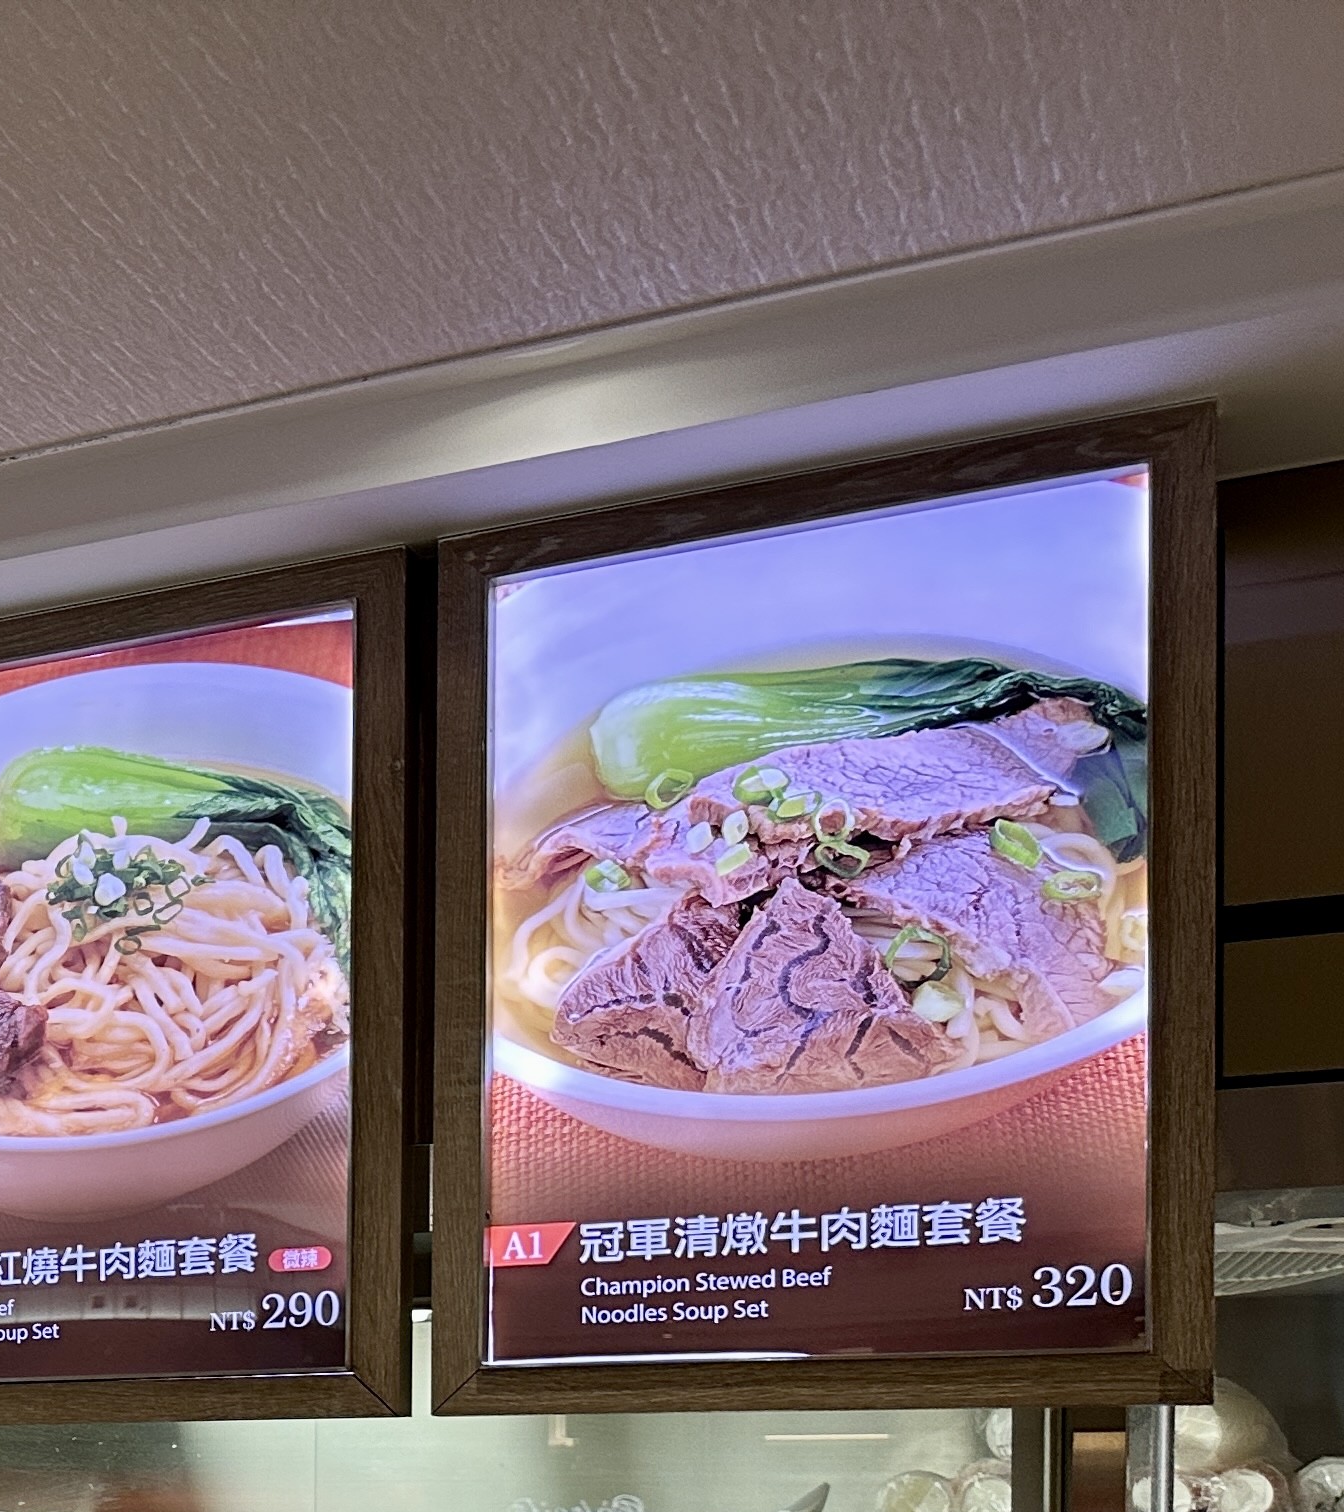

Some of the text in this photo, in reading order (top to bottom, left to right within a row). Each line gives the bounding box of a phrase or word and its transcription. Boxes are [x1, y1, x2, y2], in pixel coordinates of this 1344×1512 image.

[502, 1230, 544, 1261] A1
[578, 1197, 1027, 1266] 冠軍清燉牛肉麵套餐
[580, 1265, 832, 1300] Champion Stewed Beef
[963, 1262, 1133, 1313] NT$ 320
[209, 1289, 340, 1333] NT$ 290
[580, 1299, 769, 1325] Noodles Soup Set
[31, 1321, 60, 1341] Set
